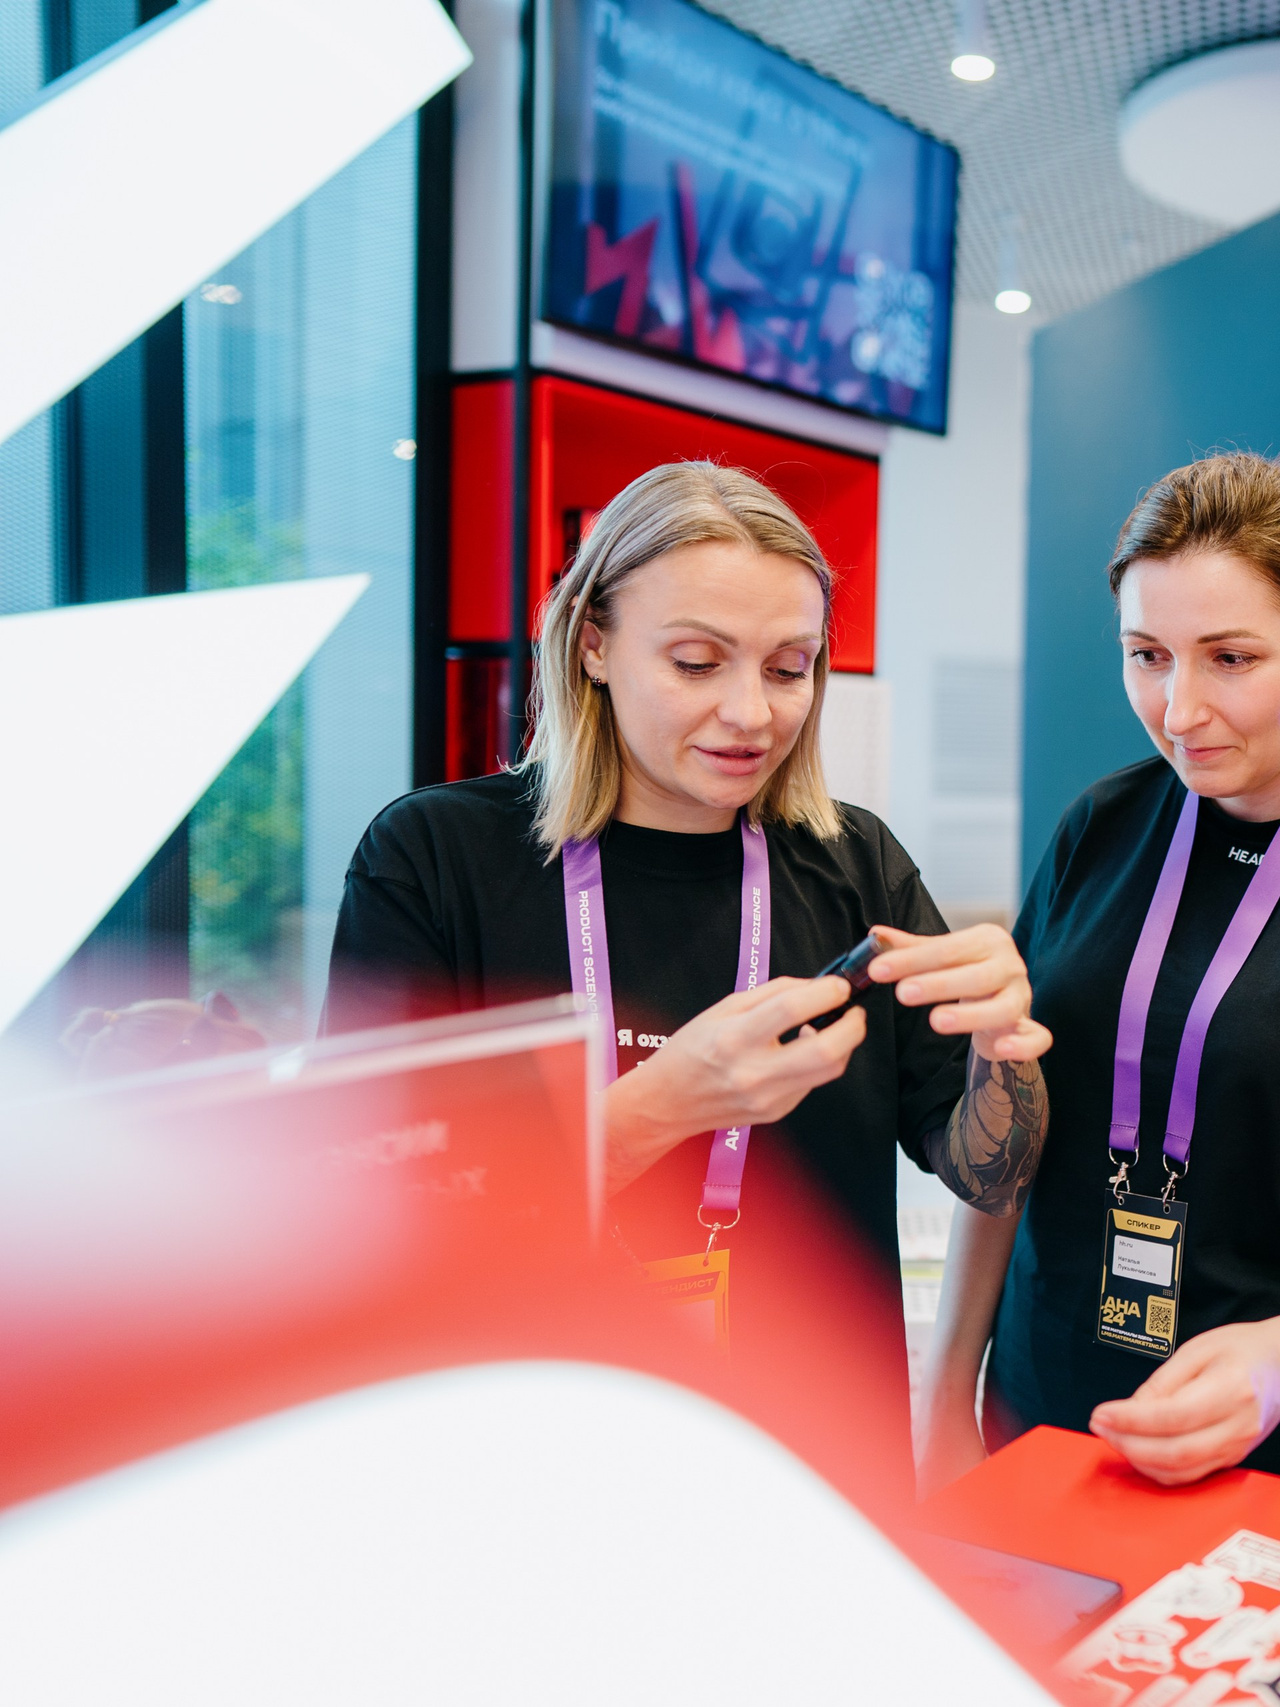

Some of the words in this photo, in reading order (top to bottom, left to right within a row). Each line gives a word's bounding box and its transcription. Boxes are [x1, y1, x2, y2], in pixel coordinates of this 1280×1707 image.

[579, 890, 593, 955] PRODUCT
[752, 887, 761, 946] SCIENCE
[617, 1029, 633, 1046] Я
[1127, 1219, 1161, 1230] СПИКЕР
[1103, 1308, 1126, 1326] 24
